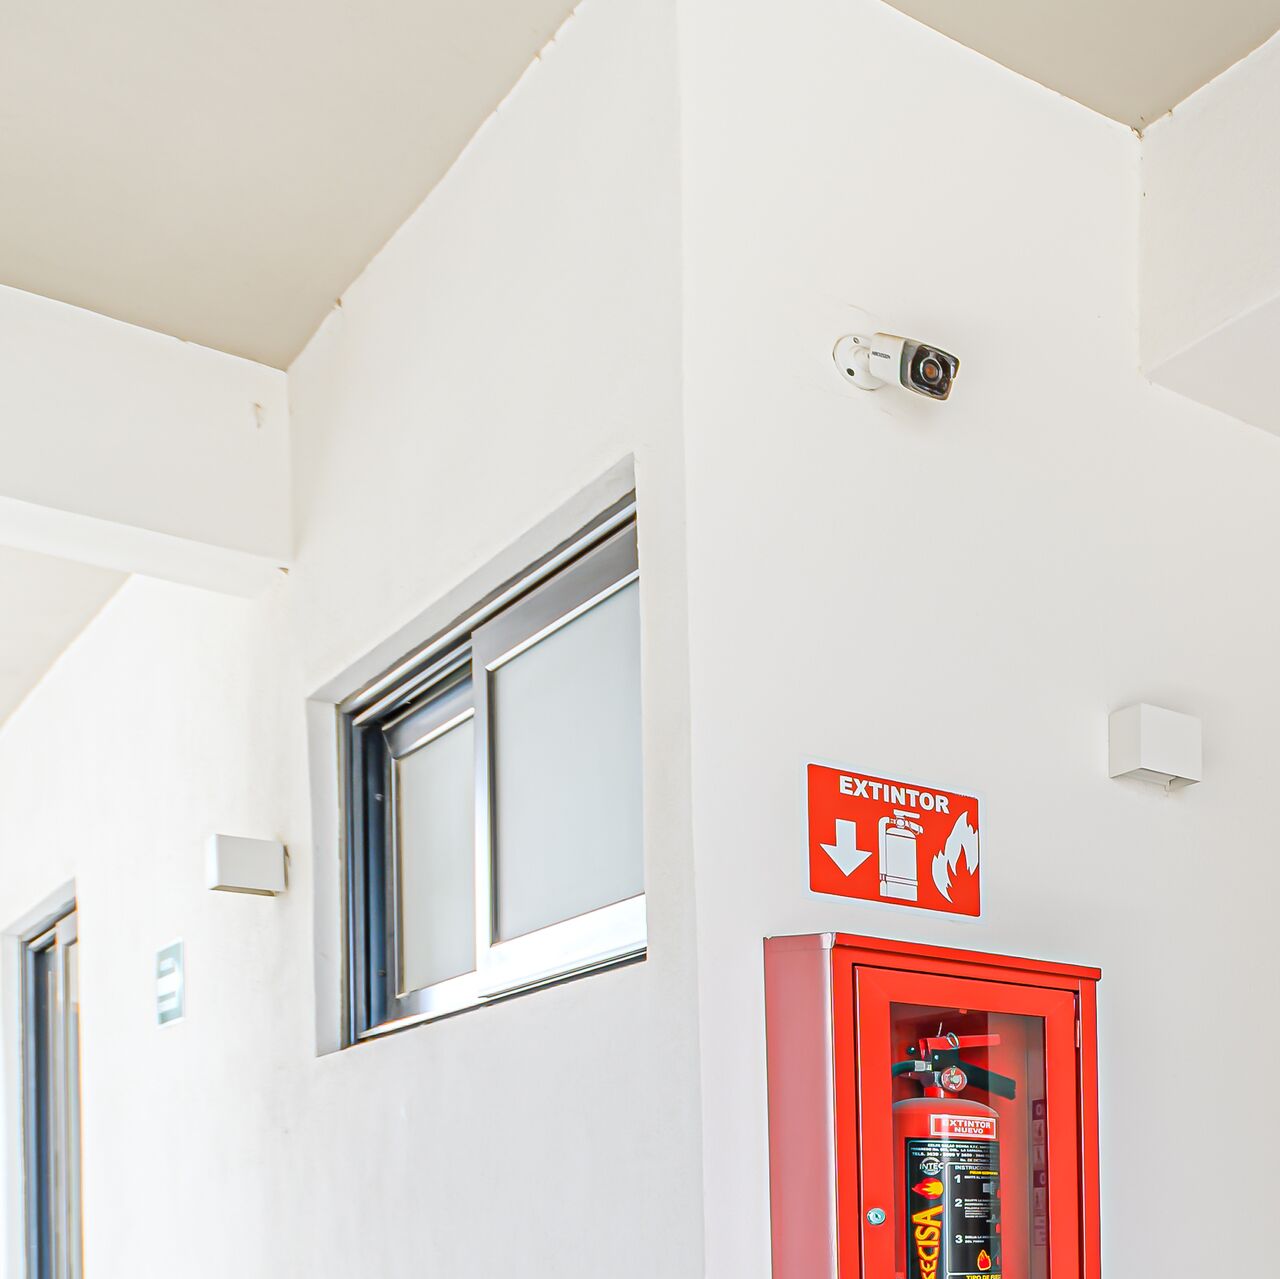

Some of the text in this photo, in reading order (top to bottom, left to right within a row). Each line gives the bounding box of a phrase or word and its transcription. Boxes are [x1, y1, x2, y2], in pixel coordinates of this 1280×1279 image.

[839, 775, 950, 814] EXTINTOR
[941, 1119, 991, 1128] EXTINTOR
[954, 1174, 960, 1183] 1
[954, 1198, 962, 1207] 2
[955, 1234, 963, 1243] 3
